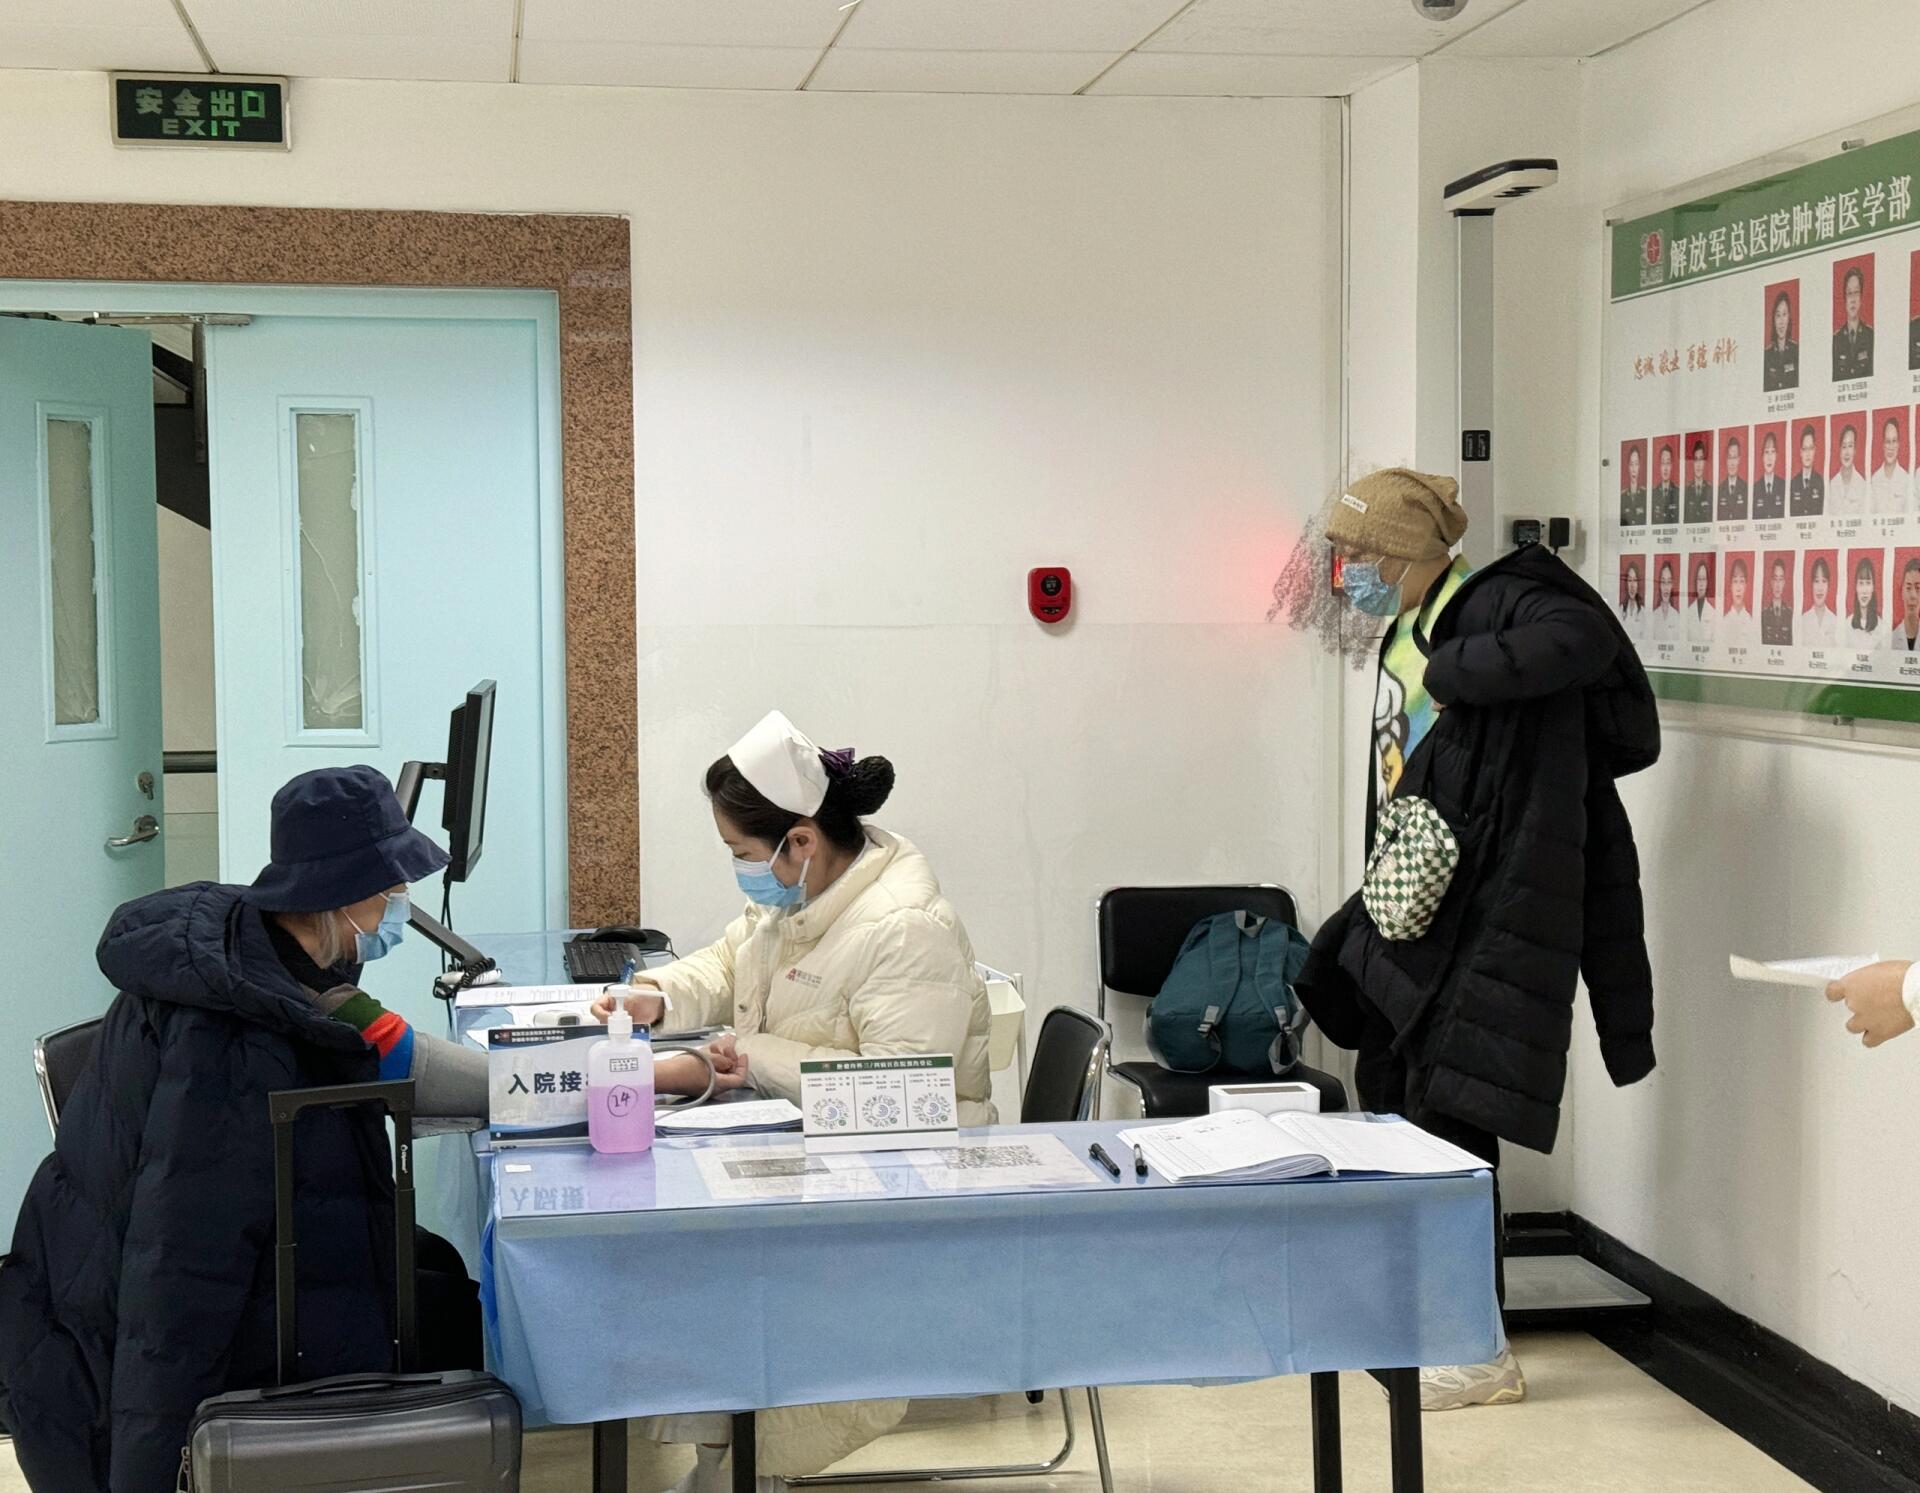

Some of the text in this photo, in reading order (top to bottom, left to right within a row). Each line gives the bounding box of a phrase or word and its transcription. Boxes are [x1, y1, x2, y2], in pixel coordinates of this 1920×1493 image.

[135, 87, 266, 118] 安全出口
[162, 118, 240, 136] EXIT
[1669, 175, 1912, 279] 解放军总医院肿瘤医学部
[508, 1071, 588, 1095] 入院接
